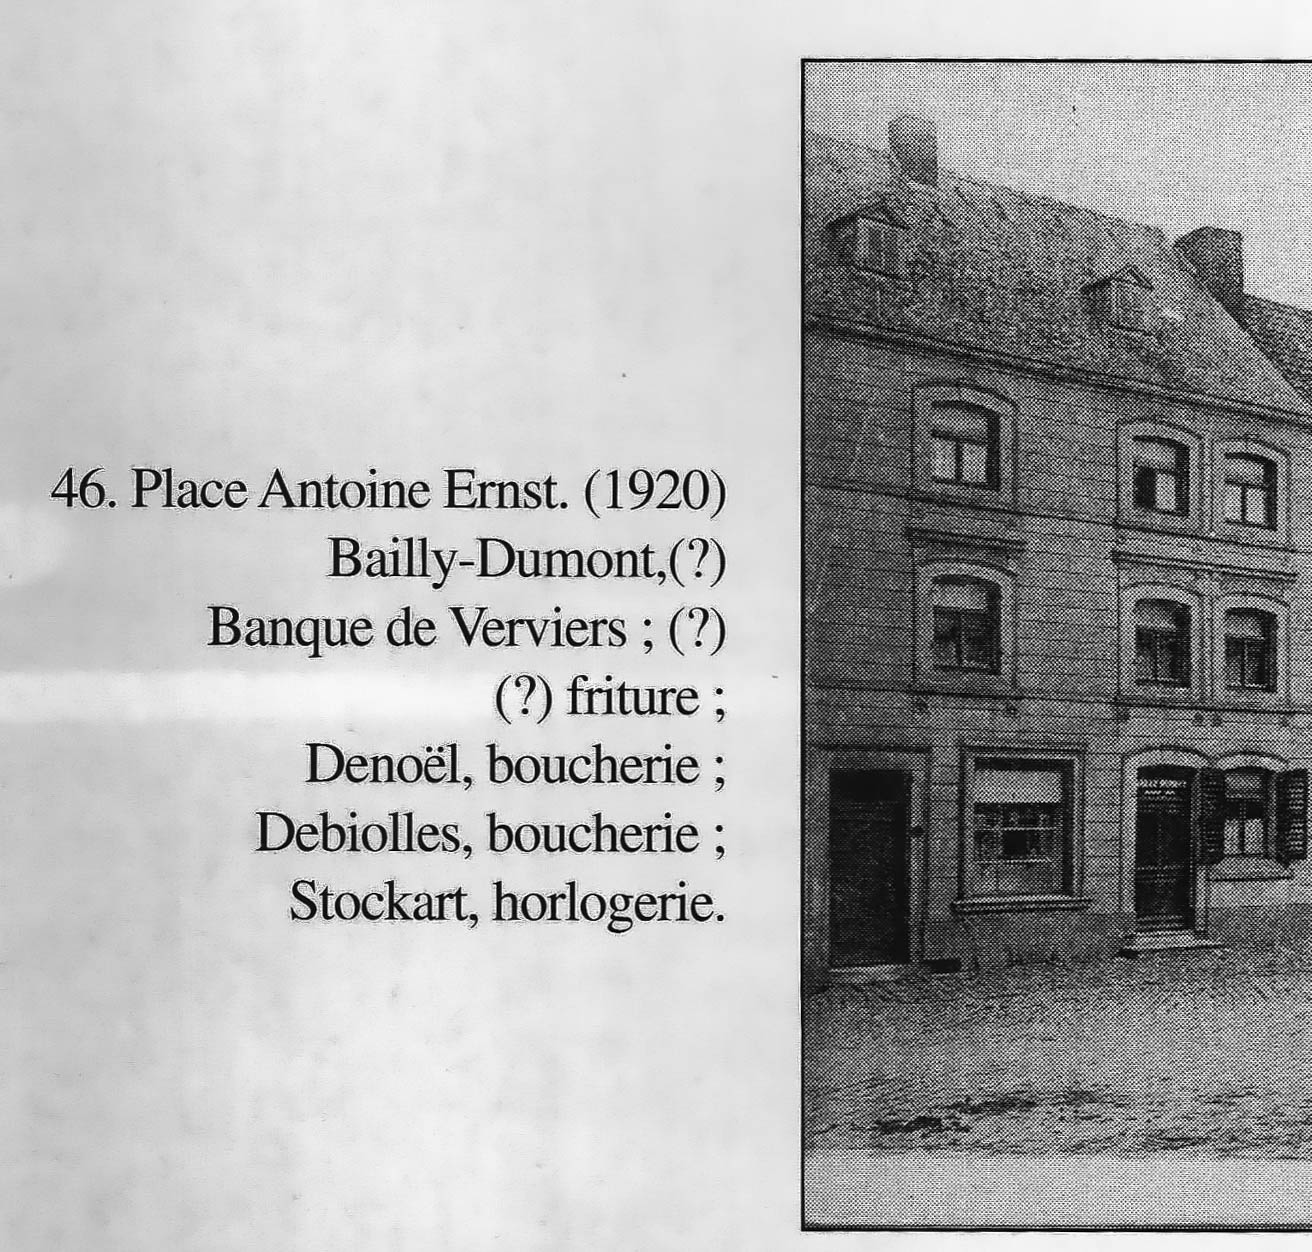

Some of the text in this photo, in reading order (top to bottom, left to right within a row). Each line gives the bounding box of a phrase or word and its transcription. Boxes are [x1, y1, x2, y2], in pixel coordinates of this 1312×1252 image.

[50, 467, 726, 519] 46. Place Antoine Ernst. (1920)
[206, 605, 726, 659] Banque de Verviers ; (?)
[495, 674, 725, 725] (?) friture ;
[305, 742, 725, 792] Denoël, boucherie ;
[255, 811, 725, 860] Debiolles, boucherie ;
[290, 879, 724, 934] Stockart, horlogerie.
